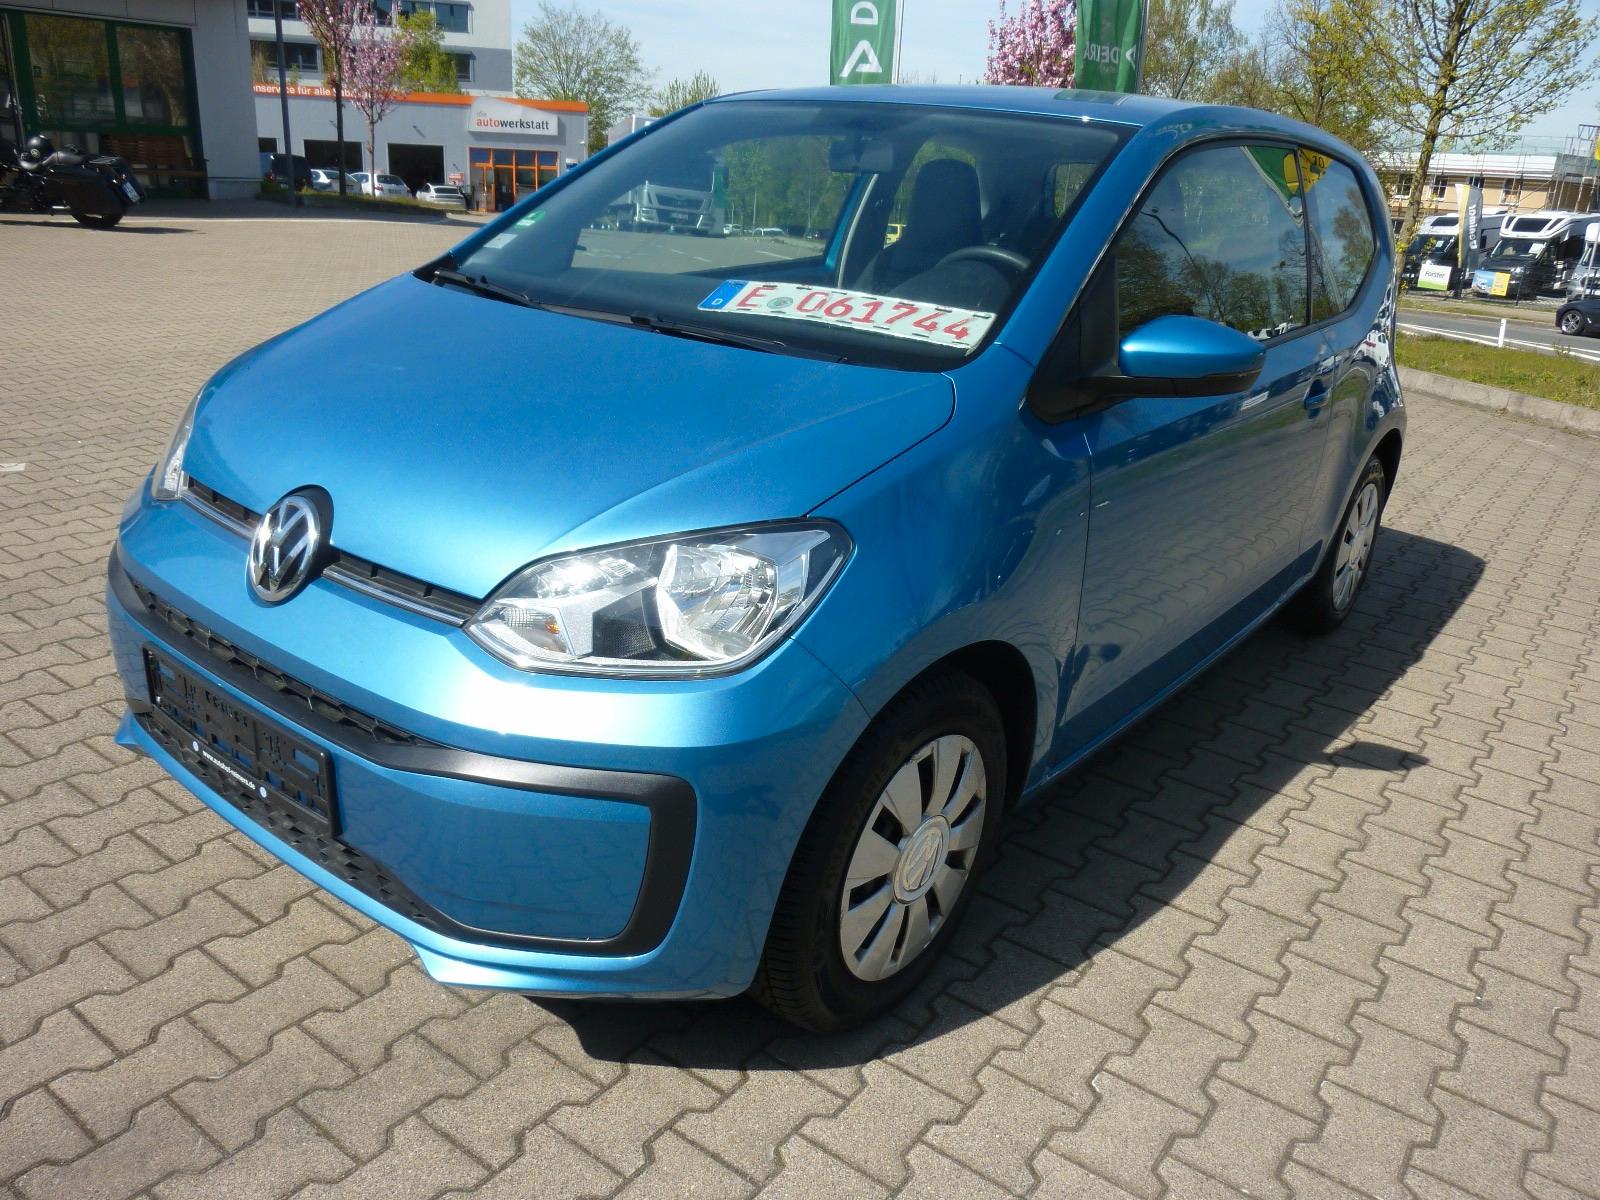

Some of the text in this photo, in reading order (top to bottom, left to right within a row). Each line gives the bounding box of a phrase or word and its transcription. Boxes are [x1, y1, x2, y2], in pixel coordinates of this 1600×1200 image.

[314, 87, 330, 97] alle
[476, 117, 550, 131] autowerkstatt
[735, 286, 970, 341] E 061744
[252, 498, 318, 598] VW
